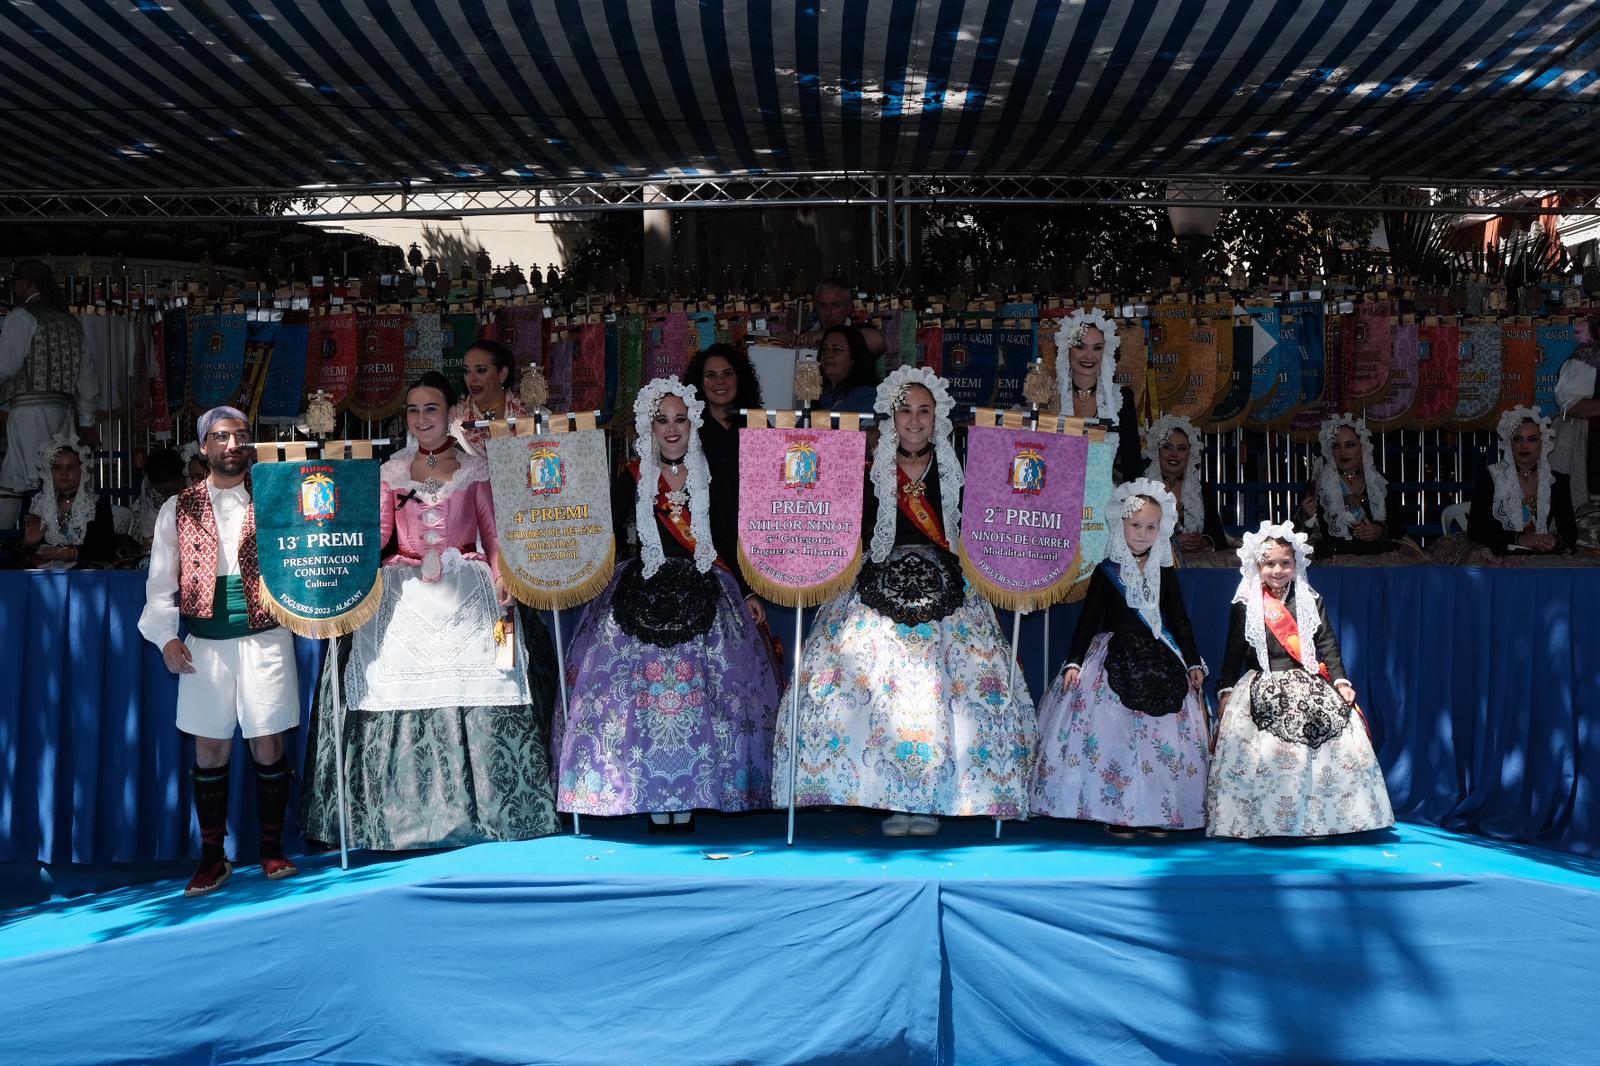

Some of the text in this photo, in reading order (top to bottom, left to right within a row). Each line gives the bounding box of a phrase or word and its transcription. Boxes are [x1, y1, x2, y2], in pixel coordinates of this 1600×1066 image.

[362, 362, 394, 373] PREMI
[948, 377, 984, 389] PREMI
[998, 378, 1019, 389] EMI
[529, 504, 590, 523] PREMI
[771, 500, 831, 515] PREMI
[748, 519, 852, 532] MILLOR NINOT
[1005, 507, 1062, 530] PREMI
[306, 532, 364, 548] PREMI
[970, 530, 1071, 549] NINOTS DE CARRER
[750, 545, 849, 557] Fogueres Infantils
[983, 546, 1058, 561] Modalitat Infantil
[294, 566, 350, 577] CONJUNTA
[978, 559, 1014, 585] FOGUERES
[1033, 566, 1062, 586] ALACANT
[304, 578, 338, 588] Cultural
[279, 593, 314, 613] FOGUERES
[313, 607, 331, 615] 2023
[335, 589, 363, 612] ALACANT
